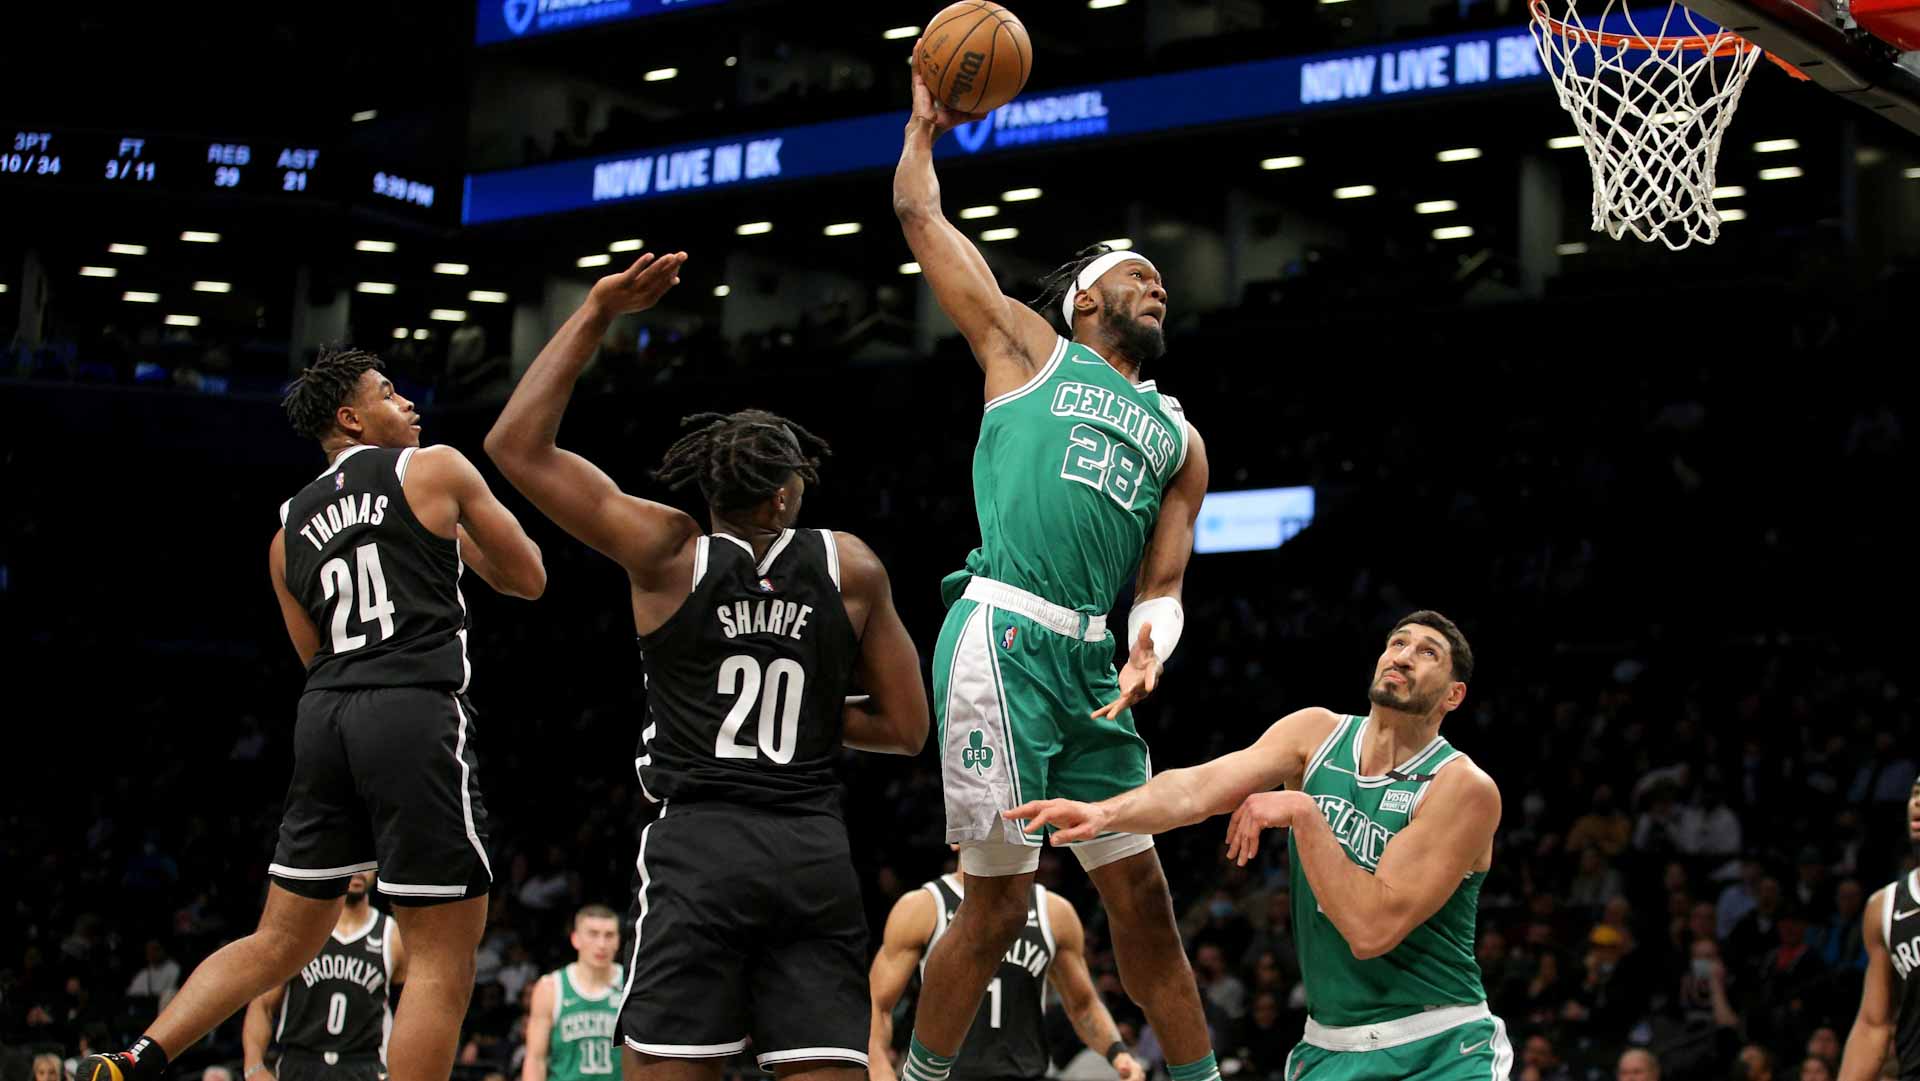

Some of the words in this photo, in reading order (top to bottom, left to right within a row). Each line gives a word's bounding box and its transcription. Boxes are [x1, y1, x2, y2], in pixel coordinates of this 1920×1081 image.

[1300, 54, 1377, 104] NOW
[1381, 45, 1450, 94] LIVE
[1455, 40, 1490, 85] IN
[1496, 34, 1541, 80] BK
[994, 91, 1109, 130] FANDUEL
[14, 132, 52, 152] 3PT
[118, 138, 145, 158] FT
[207, 144, 250, 165] REB
[276, 148, 320, 170] AST
[37, 155, 61, 175] 34
[105, 159, 118, 179] 3
[135, 162, 156, 181] 11
[214, 166, 240, 187] 39
[283, 170, 307, 191] 21
[593, 156, 654, 200] NOW
[655, 148, 711, 191] LIVE
[713, 143, 742, 184] IN
[745, 137, 783, 180] BK
[406, 181, 434, 208] PM
[1051, 382, 1175, 477] CELTICS
[1060, 423, 1146, 511] 28
[300, 493, 388, 551] THOMAS
[320, 543, 395, 654] 24
[717, 600, 813, 640] SHARPE
[715, 655, 805, 764] 20
[967, 749, 987, 761] RED
[1387, 792, 1410, 803] VISTA
[300, 954, 384, 994] BROOKLYN
[327, 992, 347, 1035] 0
[987, 978, 1001, 1028] 1
[579, 1039, 613, 1074] 11
